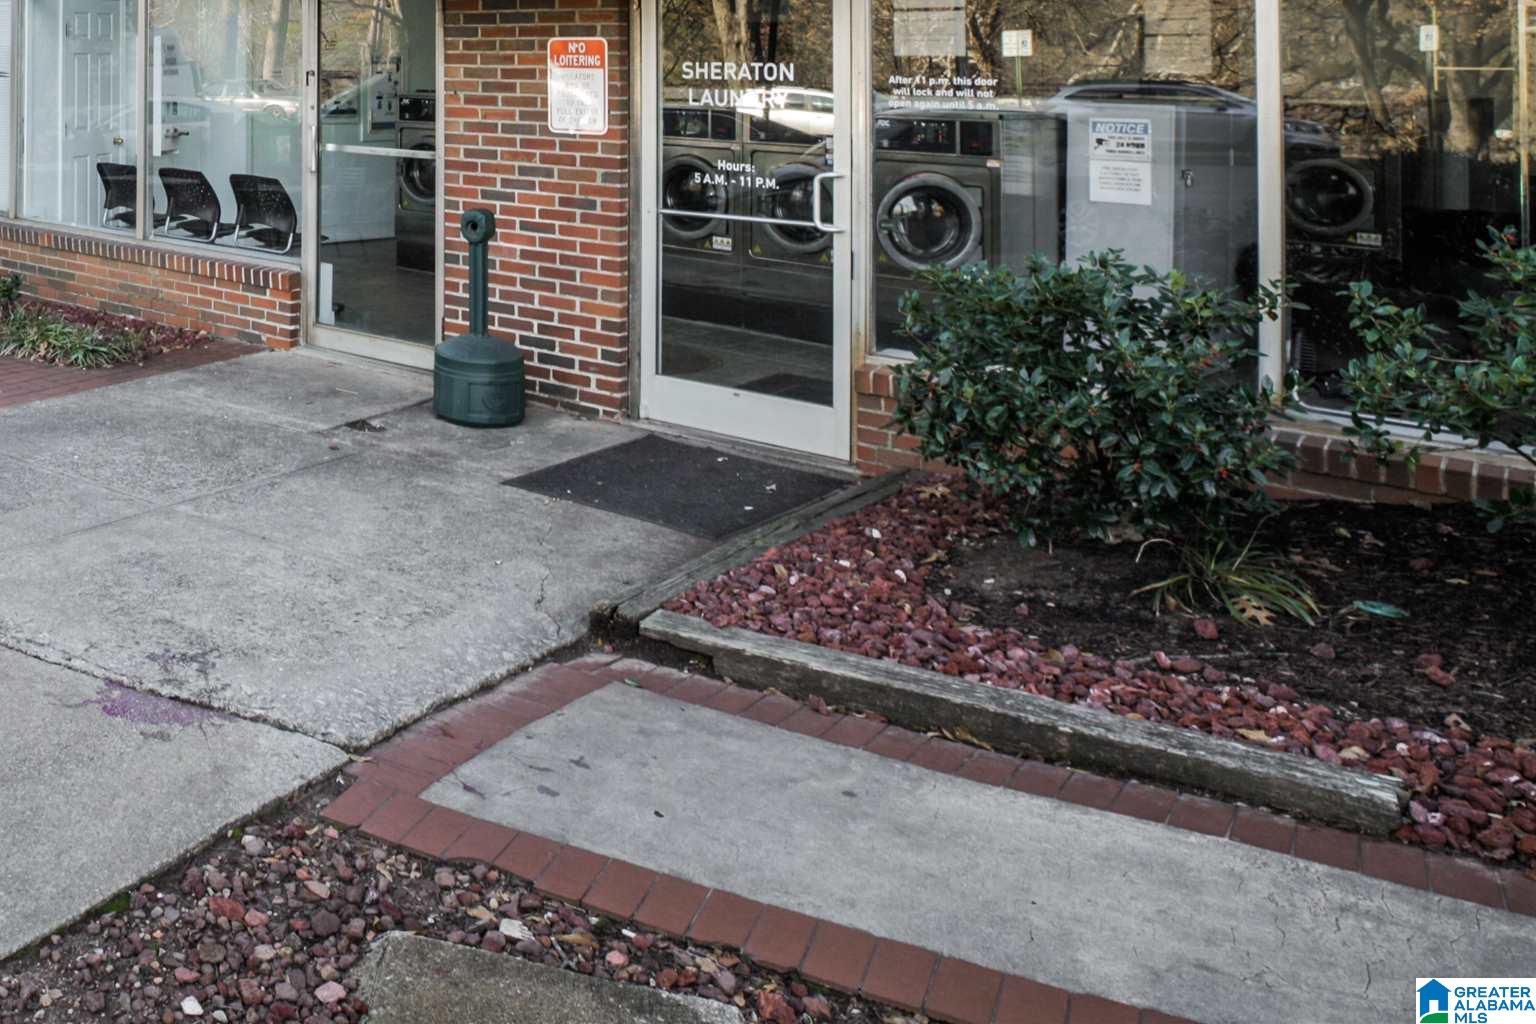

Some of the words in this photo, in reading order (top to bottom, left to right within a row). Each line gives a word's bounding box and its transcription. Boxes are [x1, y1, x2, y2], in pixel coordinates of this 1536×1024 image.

[568, 42, 586, 54] NO
[554, 55, 601, 67] LOITERING
[681, 61, 795, 82] SHERATON
[888, 75, 912, 84] After
[953, 76, 972, 85] this
[974, 77, 998, 86] door
[688, 88, 788, 109] LAUNRY
[894, 87, 910, 96] will
[913, 87, 933, 96] lock
[935, 88, 954, 97] and
[955, 88, 974, 97] will
[976, 89, 994, 98] not
[914, 100, 940, 110] again
[943, 100, 965, 109] until
[976, 102, 1000, 111] a.m.
[1095, 123, 1145, 135] NOTICE
[717, 159, 756, 173] Hours:
[694, 172, 701, 184] 5
[703, 173, 728, 186] A.M.
[740, 176, 752, 188] 11
[755, 177, 780, 190] P.M.
